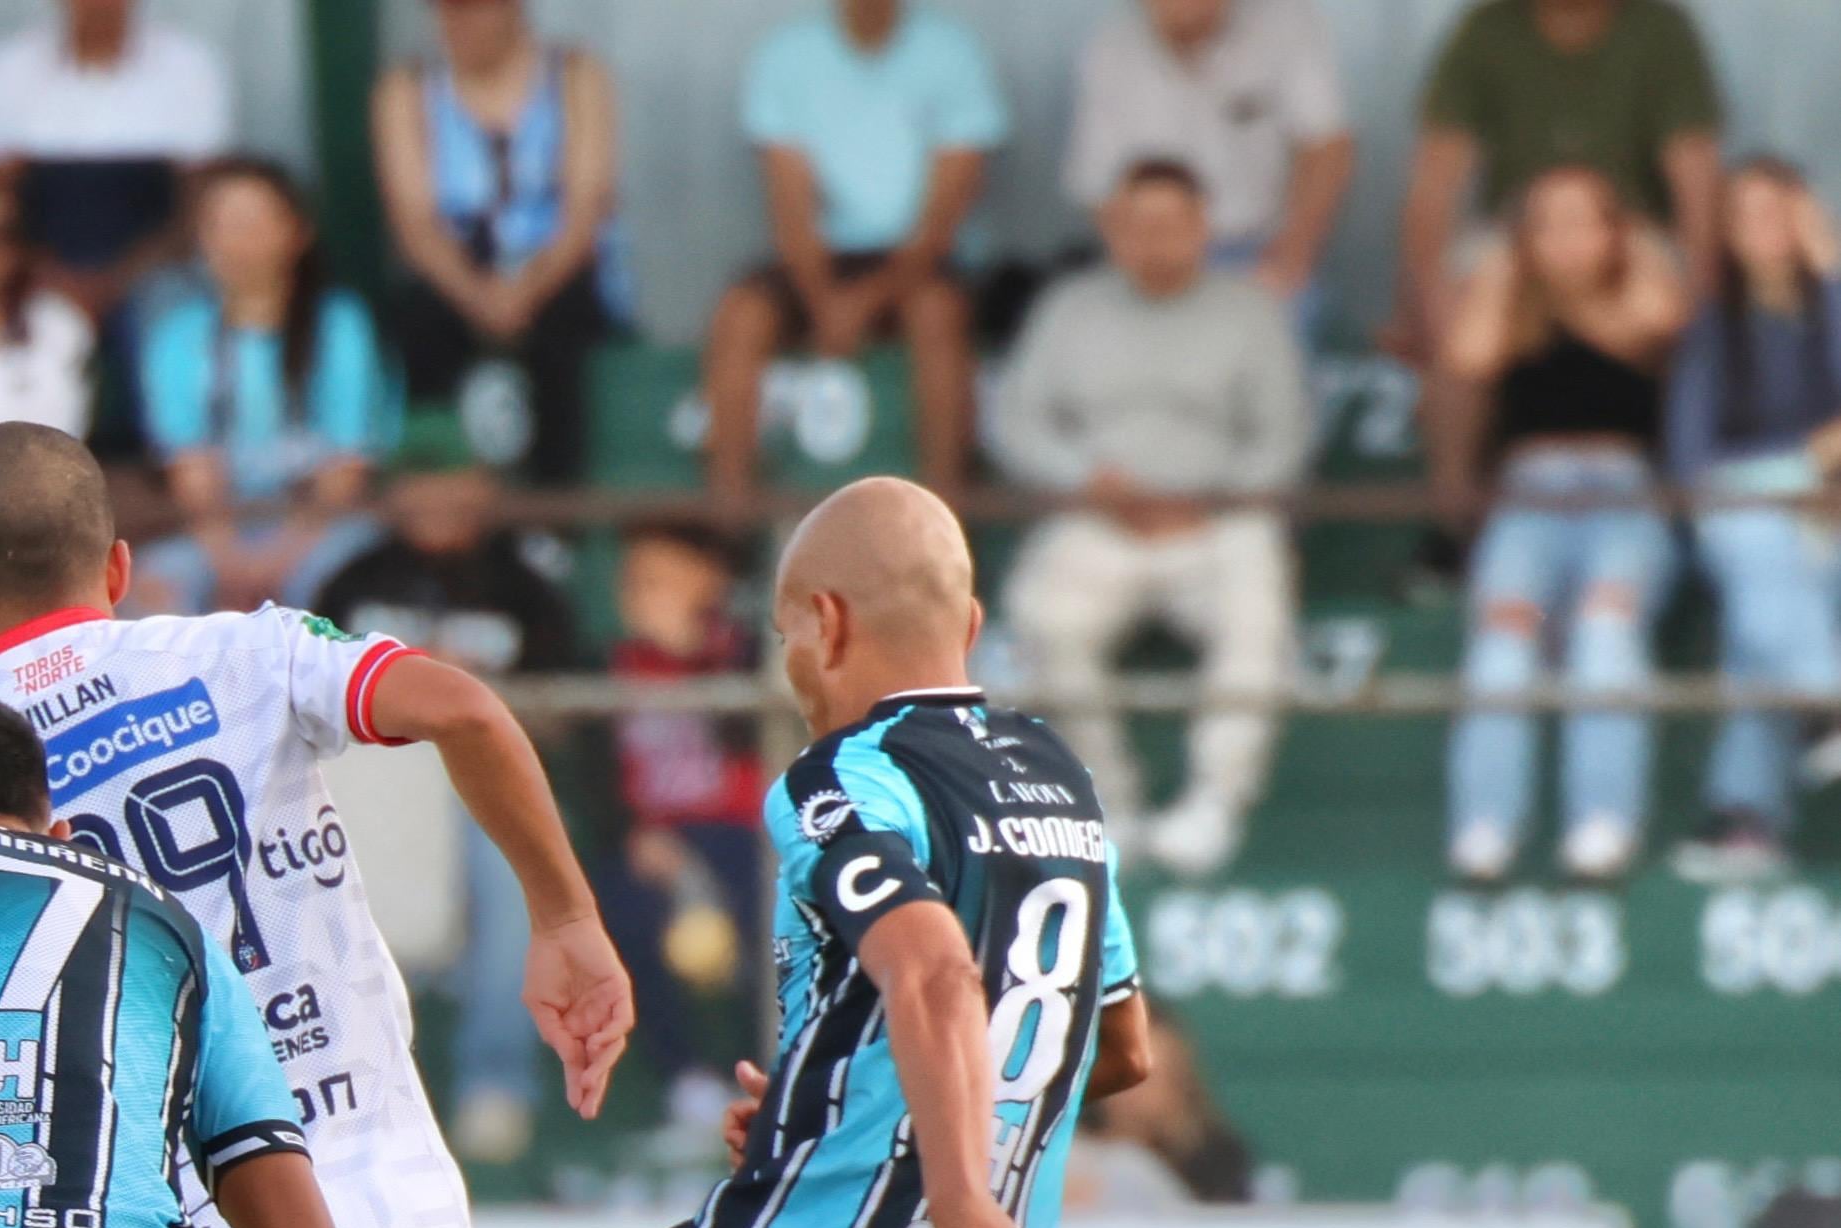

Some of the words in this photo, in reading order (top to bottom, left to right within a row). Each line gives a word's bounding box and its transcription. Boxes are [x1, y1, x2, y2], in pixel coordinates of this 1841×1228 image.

[13, 644, 74, 684] TOROS
[25, 656, 85, 696] NORTE
[46, 699, 212, 790] Coocique
[837, 855, 903, 912] C
[988, 877, 1090, 1100] 8
